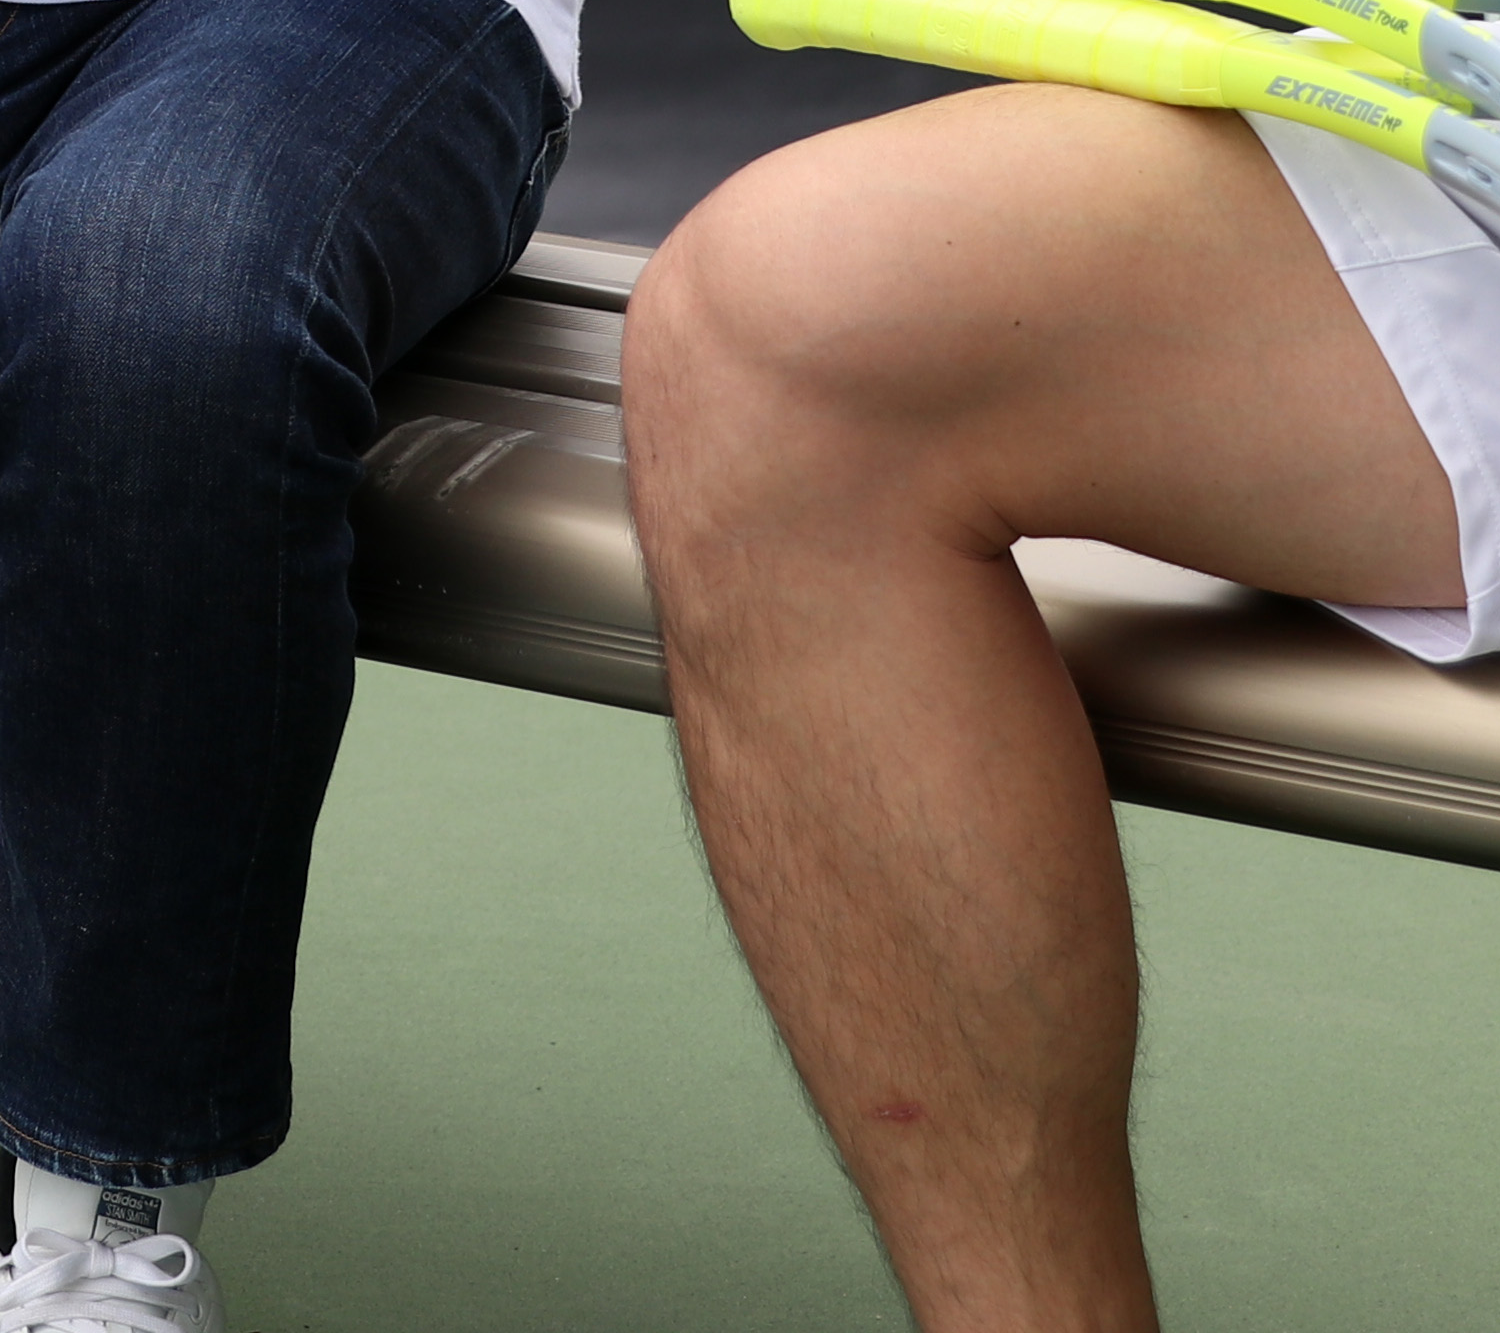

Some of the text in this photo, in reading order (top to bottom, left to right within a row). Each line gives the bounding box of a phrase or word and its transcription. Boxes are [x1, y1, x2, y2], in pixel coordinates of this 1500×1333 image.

[1374, 9, 1410, 35] TOUR
[1264, 75, 1388, 127] EXTREME
[1380, 115, 1403, 133] MP
[102, 1191, 143, 1210] adidas
[105, 1203, 126, 1220] STAN
